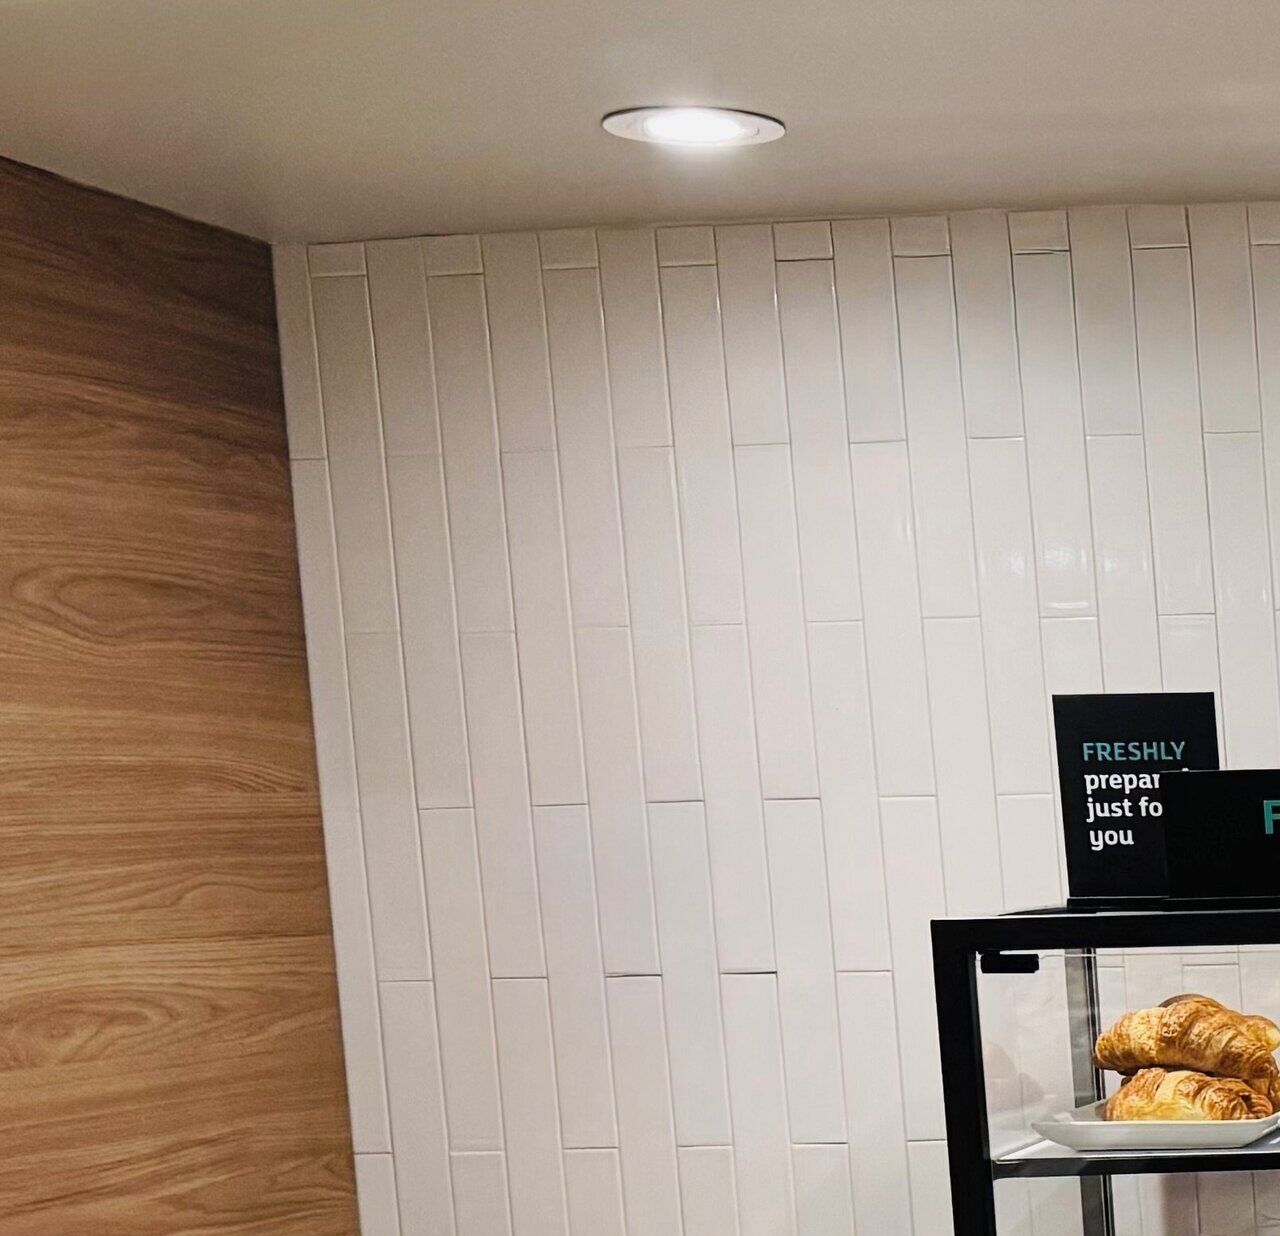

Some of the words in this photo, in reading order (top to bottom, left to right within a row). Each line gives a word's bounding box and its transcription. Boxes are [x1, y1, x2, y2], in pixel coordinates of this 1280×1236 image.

[1083, 742, 1185, 761] FRESHLY
[1084, 774, 1160, 794] prepar
[1086, 797, 1133, 822] just
[1139, 797, 1162, 816] fo
[1090, 830, 1134, 850] you
